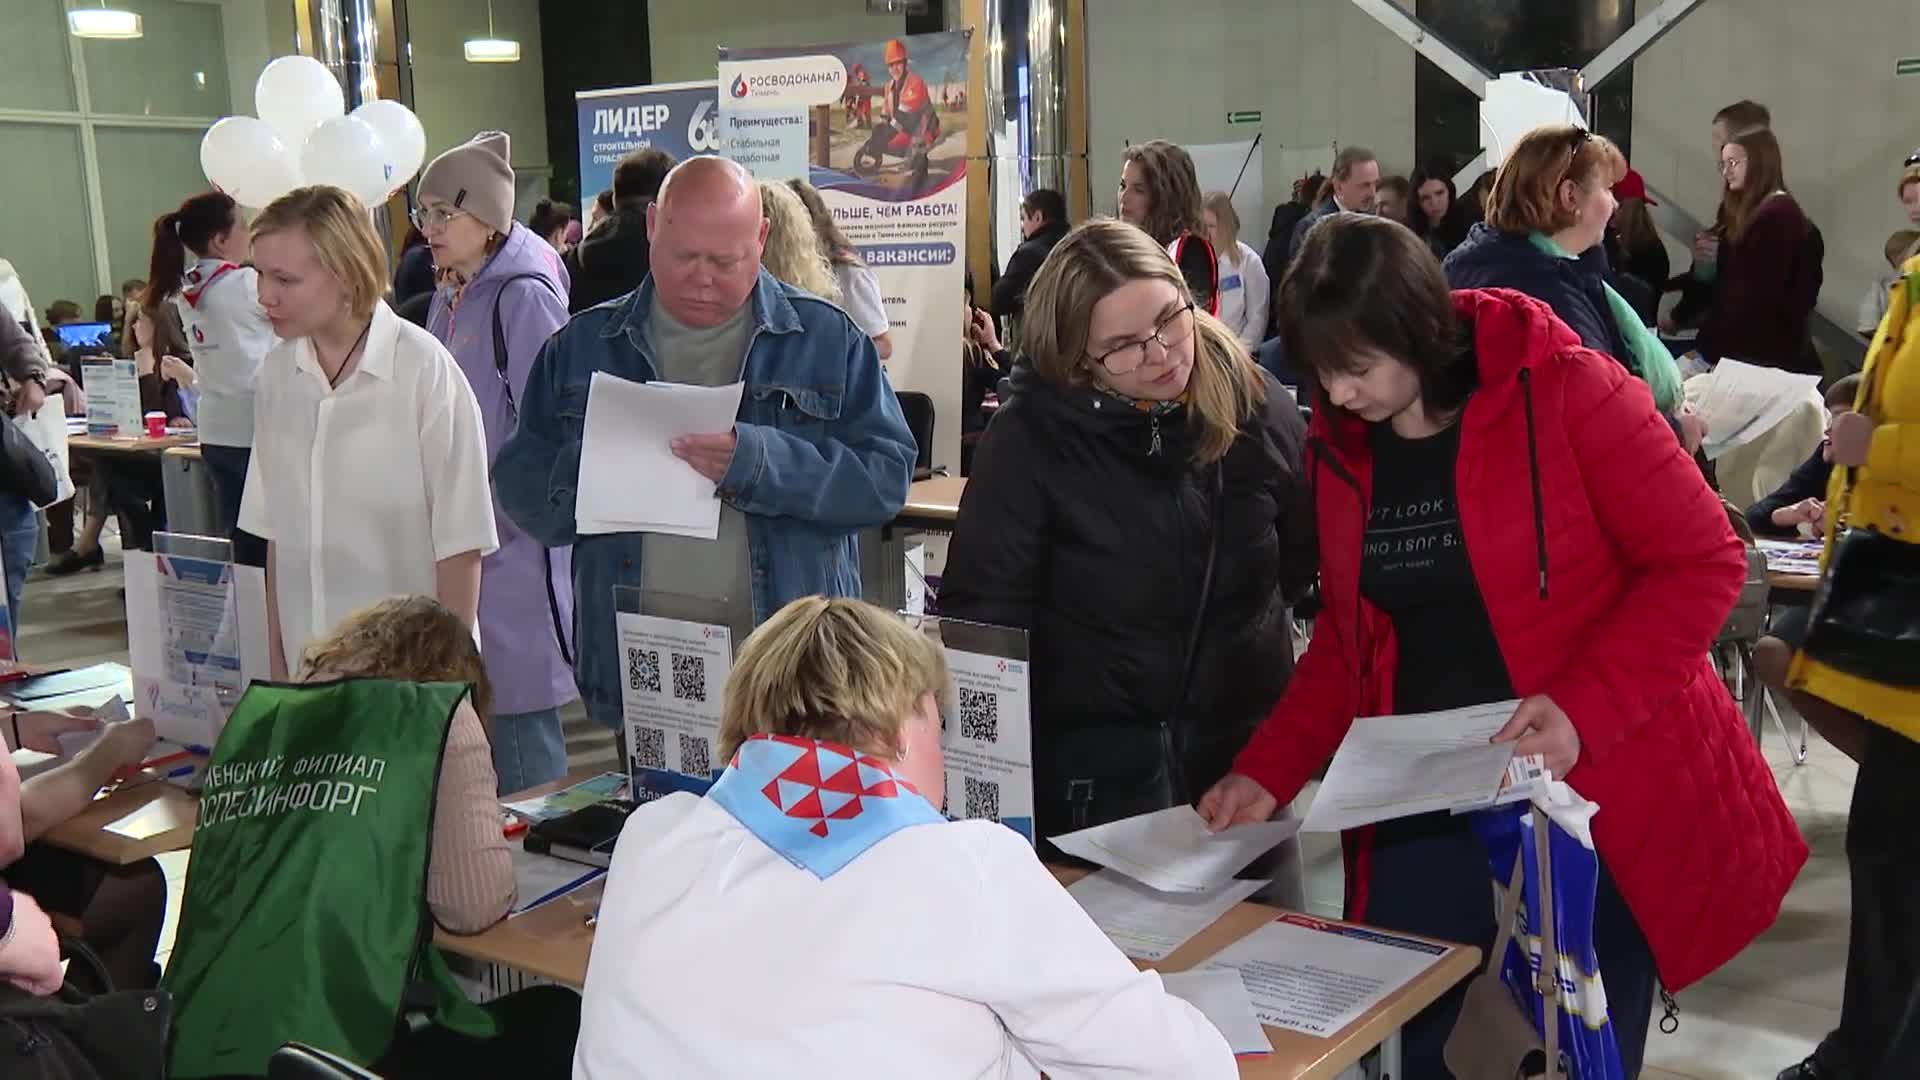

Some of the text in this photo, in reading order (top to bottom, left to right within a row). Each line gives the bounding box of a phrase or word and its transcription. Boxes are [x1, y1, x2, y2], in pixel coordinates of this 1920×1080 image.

[750, 71, 840, 87] РОСВОДОКАНАЛ
[592, 104, 670, 138] ЛИДЕР
[729, 115, 804, 129] Преимущества:
[592, 138, 652, 153] СТРОИТЕЛЬНОЙ
[730, 137, 781, 149] Стабильная
[833, 202, 958, 220] ЛЬШЕ, ЧЕМ РАБОТА!
[866, 248, 952, 263] вакансии:
[881, 296, 907, 304] итель
[888, 320, 907, 328] ник
[1395, 499, 1444, 519] LOOK
[293, 752, 386, 781] ФИЛИАЛ
